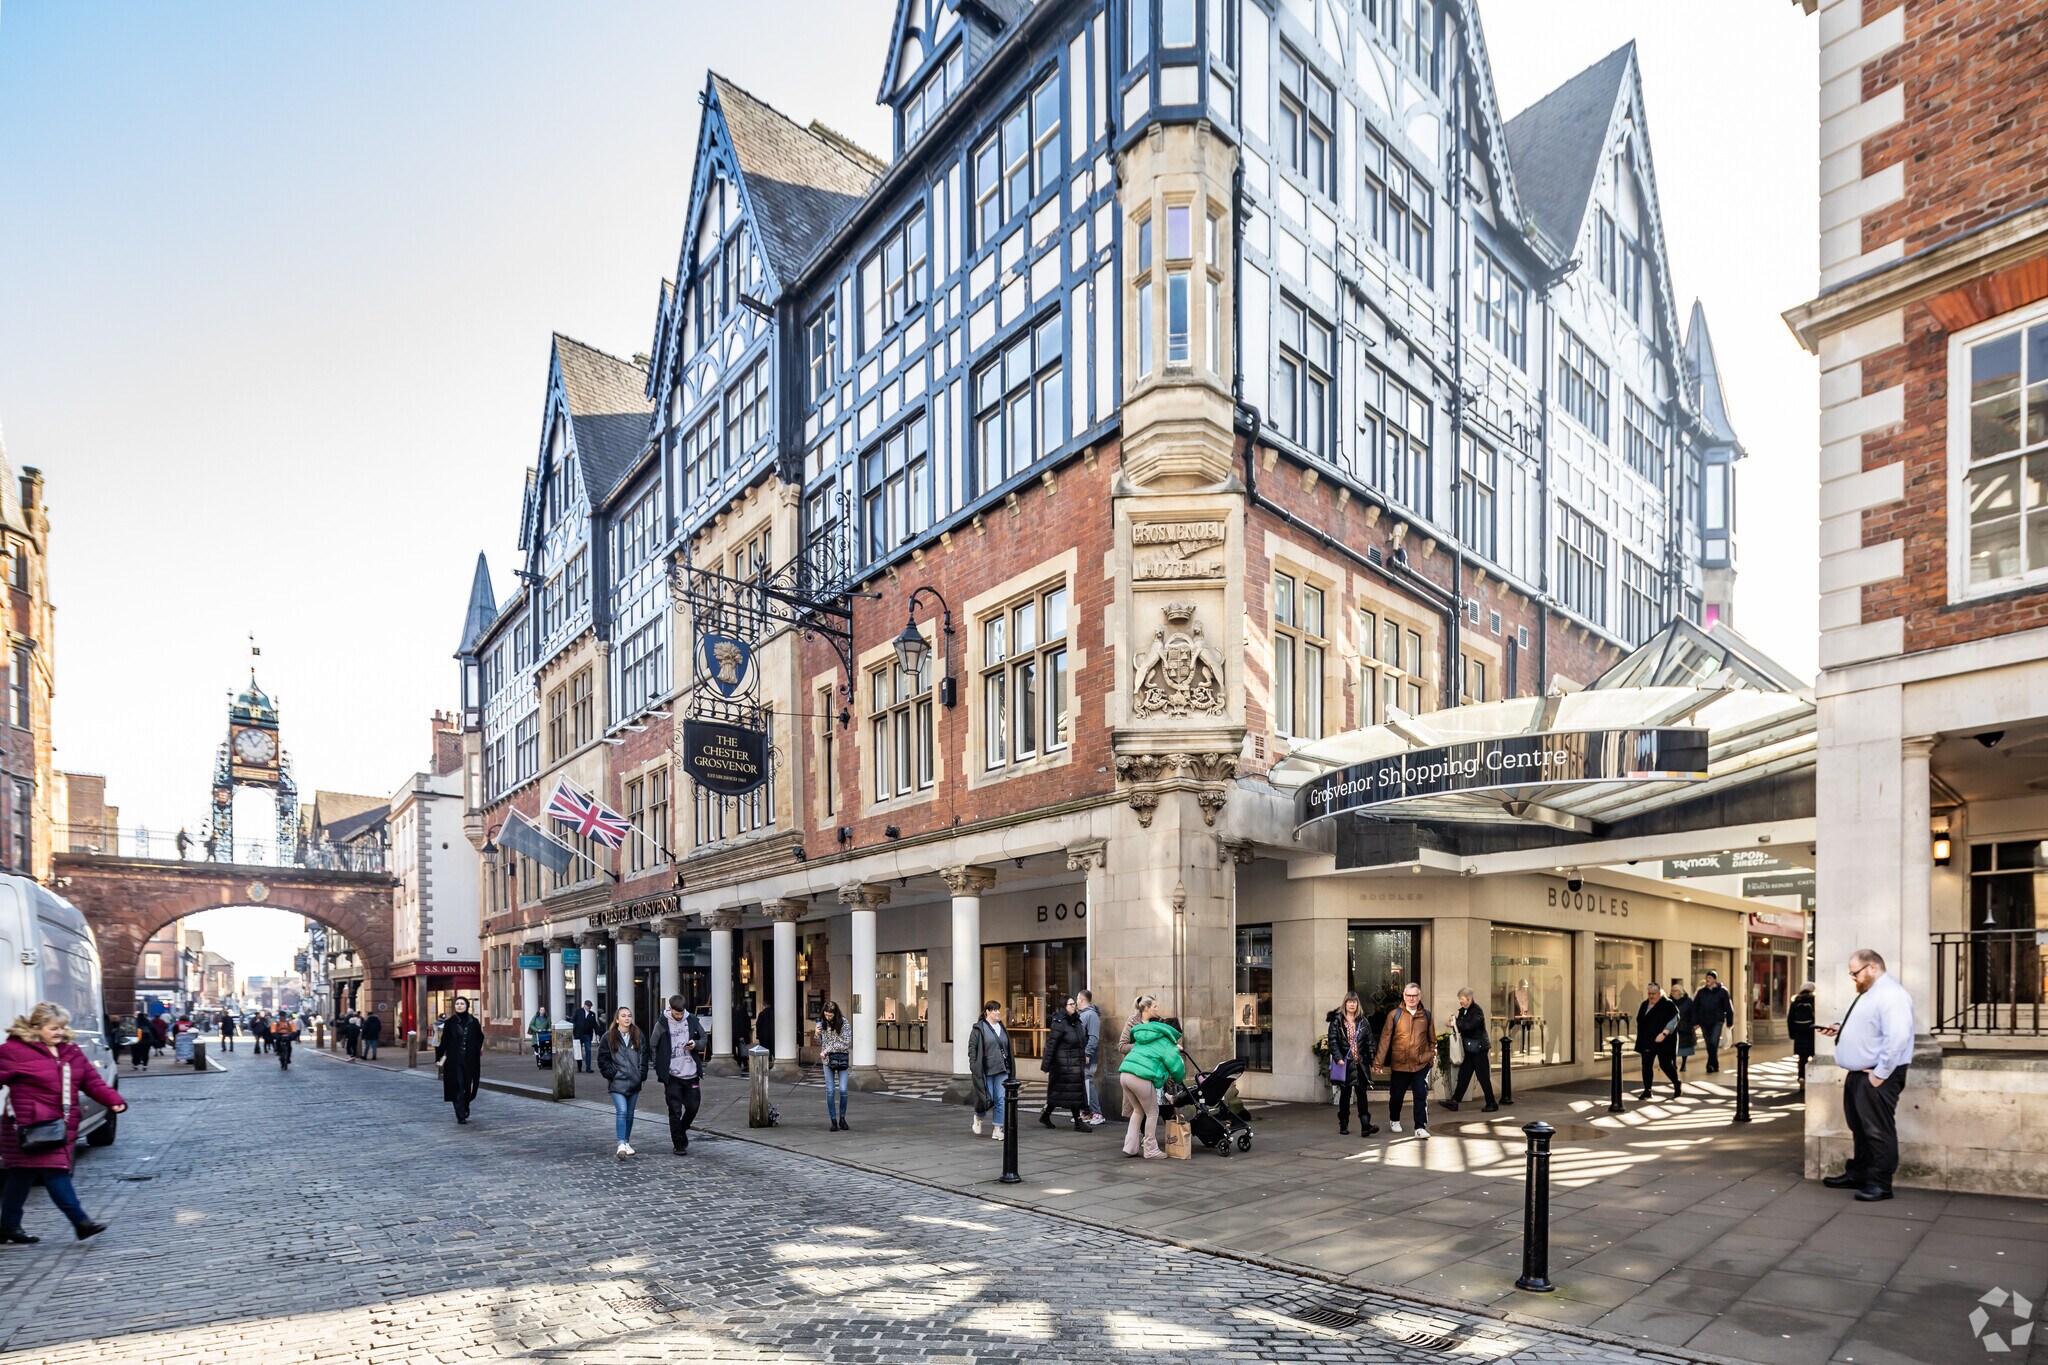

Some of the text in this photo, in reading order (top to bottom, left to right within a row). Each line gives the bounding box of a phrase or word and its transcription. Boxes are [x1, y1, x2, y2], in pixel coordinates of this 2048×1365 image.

[1134, 522, 1217, 541] GROSVENOR
[715, 734, 738, 747] THE
[703, 745, 750, 762] CHESTER
[694, 756, 758, 775] GROSVENOR
[1310, 749, 1567, 806] Grosvenor Shopping Centre
[1360, 892, 1424, 901] BOODLES
[1548, 887, 1628, 918] BOODLES
[587, 896, 678, 927] THE CHESTER GROSVENOR
[424, 965, 476, 973] S.S. MILTON
